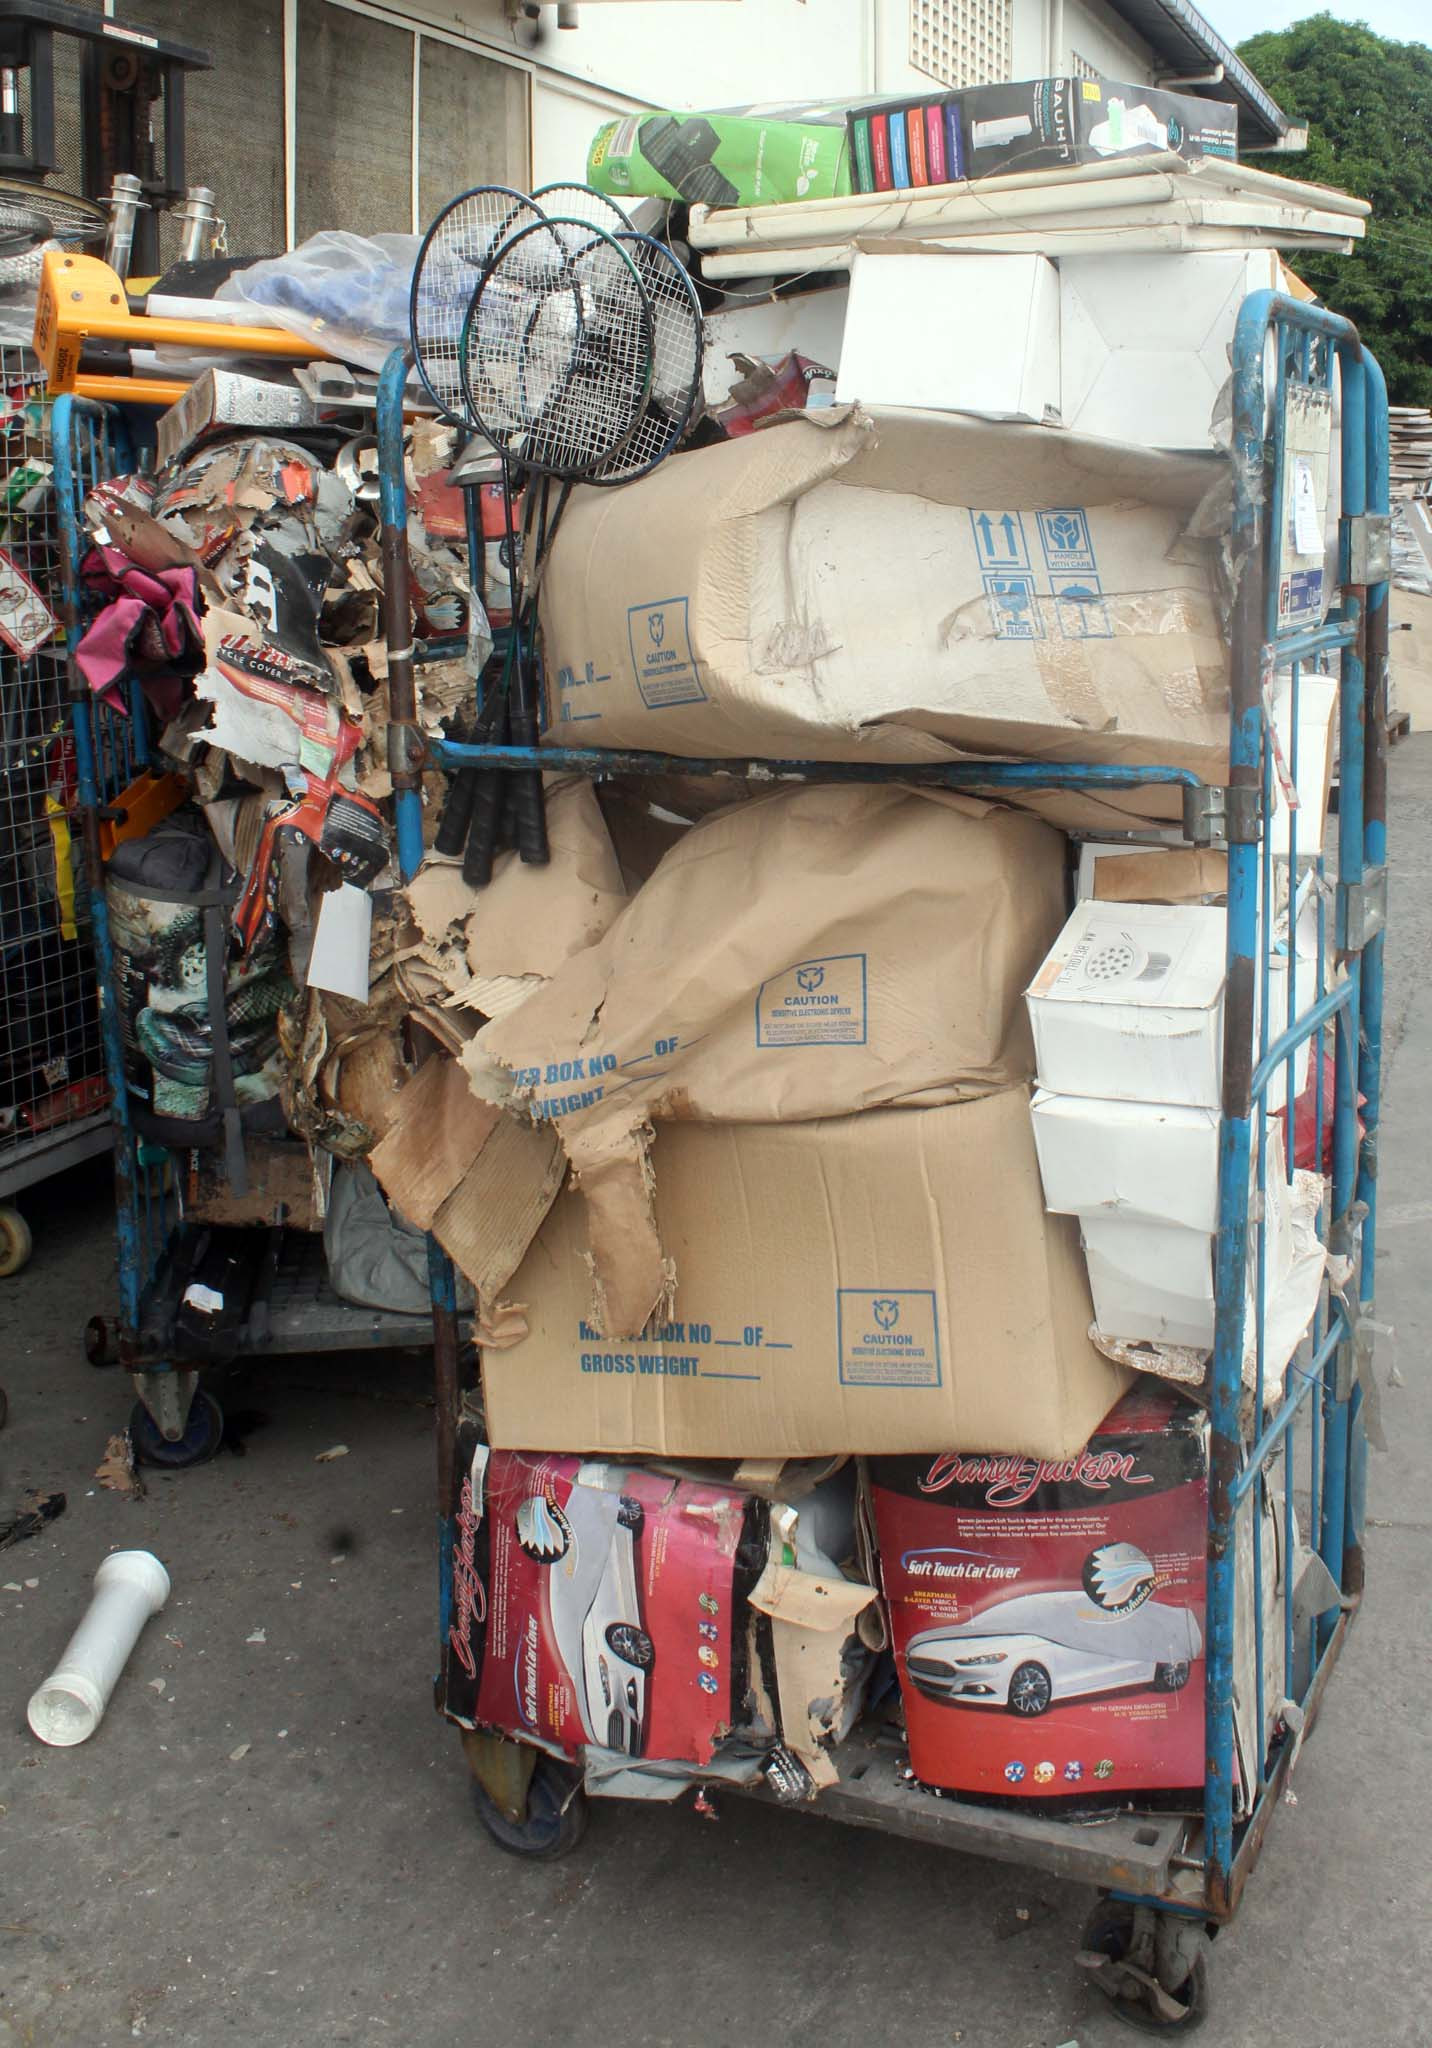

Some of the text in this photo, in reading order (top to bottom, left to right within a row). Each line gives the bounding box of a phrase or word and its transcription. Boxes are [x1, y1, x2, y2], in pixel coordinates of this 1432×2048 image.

[646, 650, 677, 664] CAUTION
[249, 660, 282, 679] COVER
[784, 995, 839, 1006] CAUTION
[546, 1058, 586, 1085] BOX
[589, 1053, 617, 1077] NO
[654, 1036, 679, 1057] OF
[689, 1324, 712, 1345] NO
[743, 1327, 764, 1347] OF
[863, 1334, 913, 1345] CAUTION
[580, 1353, 699, 1377] GROSS WEIGHT
[907, 1559, 1020, 1580] Soft Touch Car Cover
[524, 1614, 538, 1723] Soft Touch Car Cover
